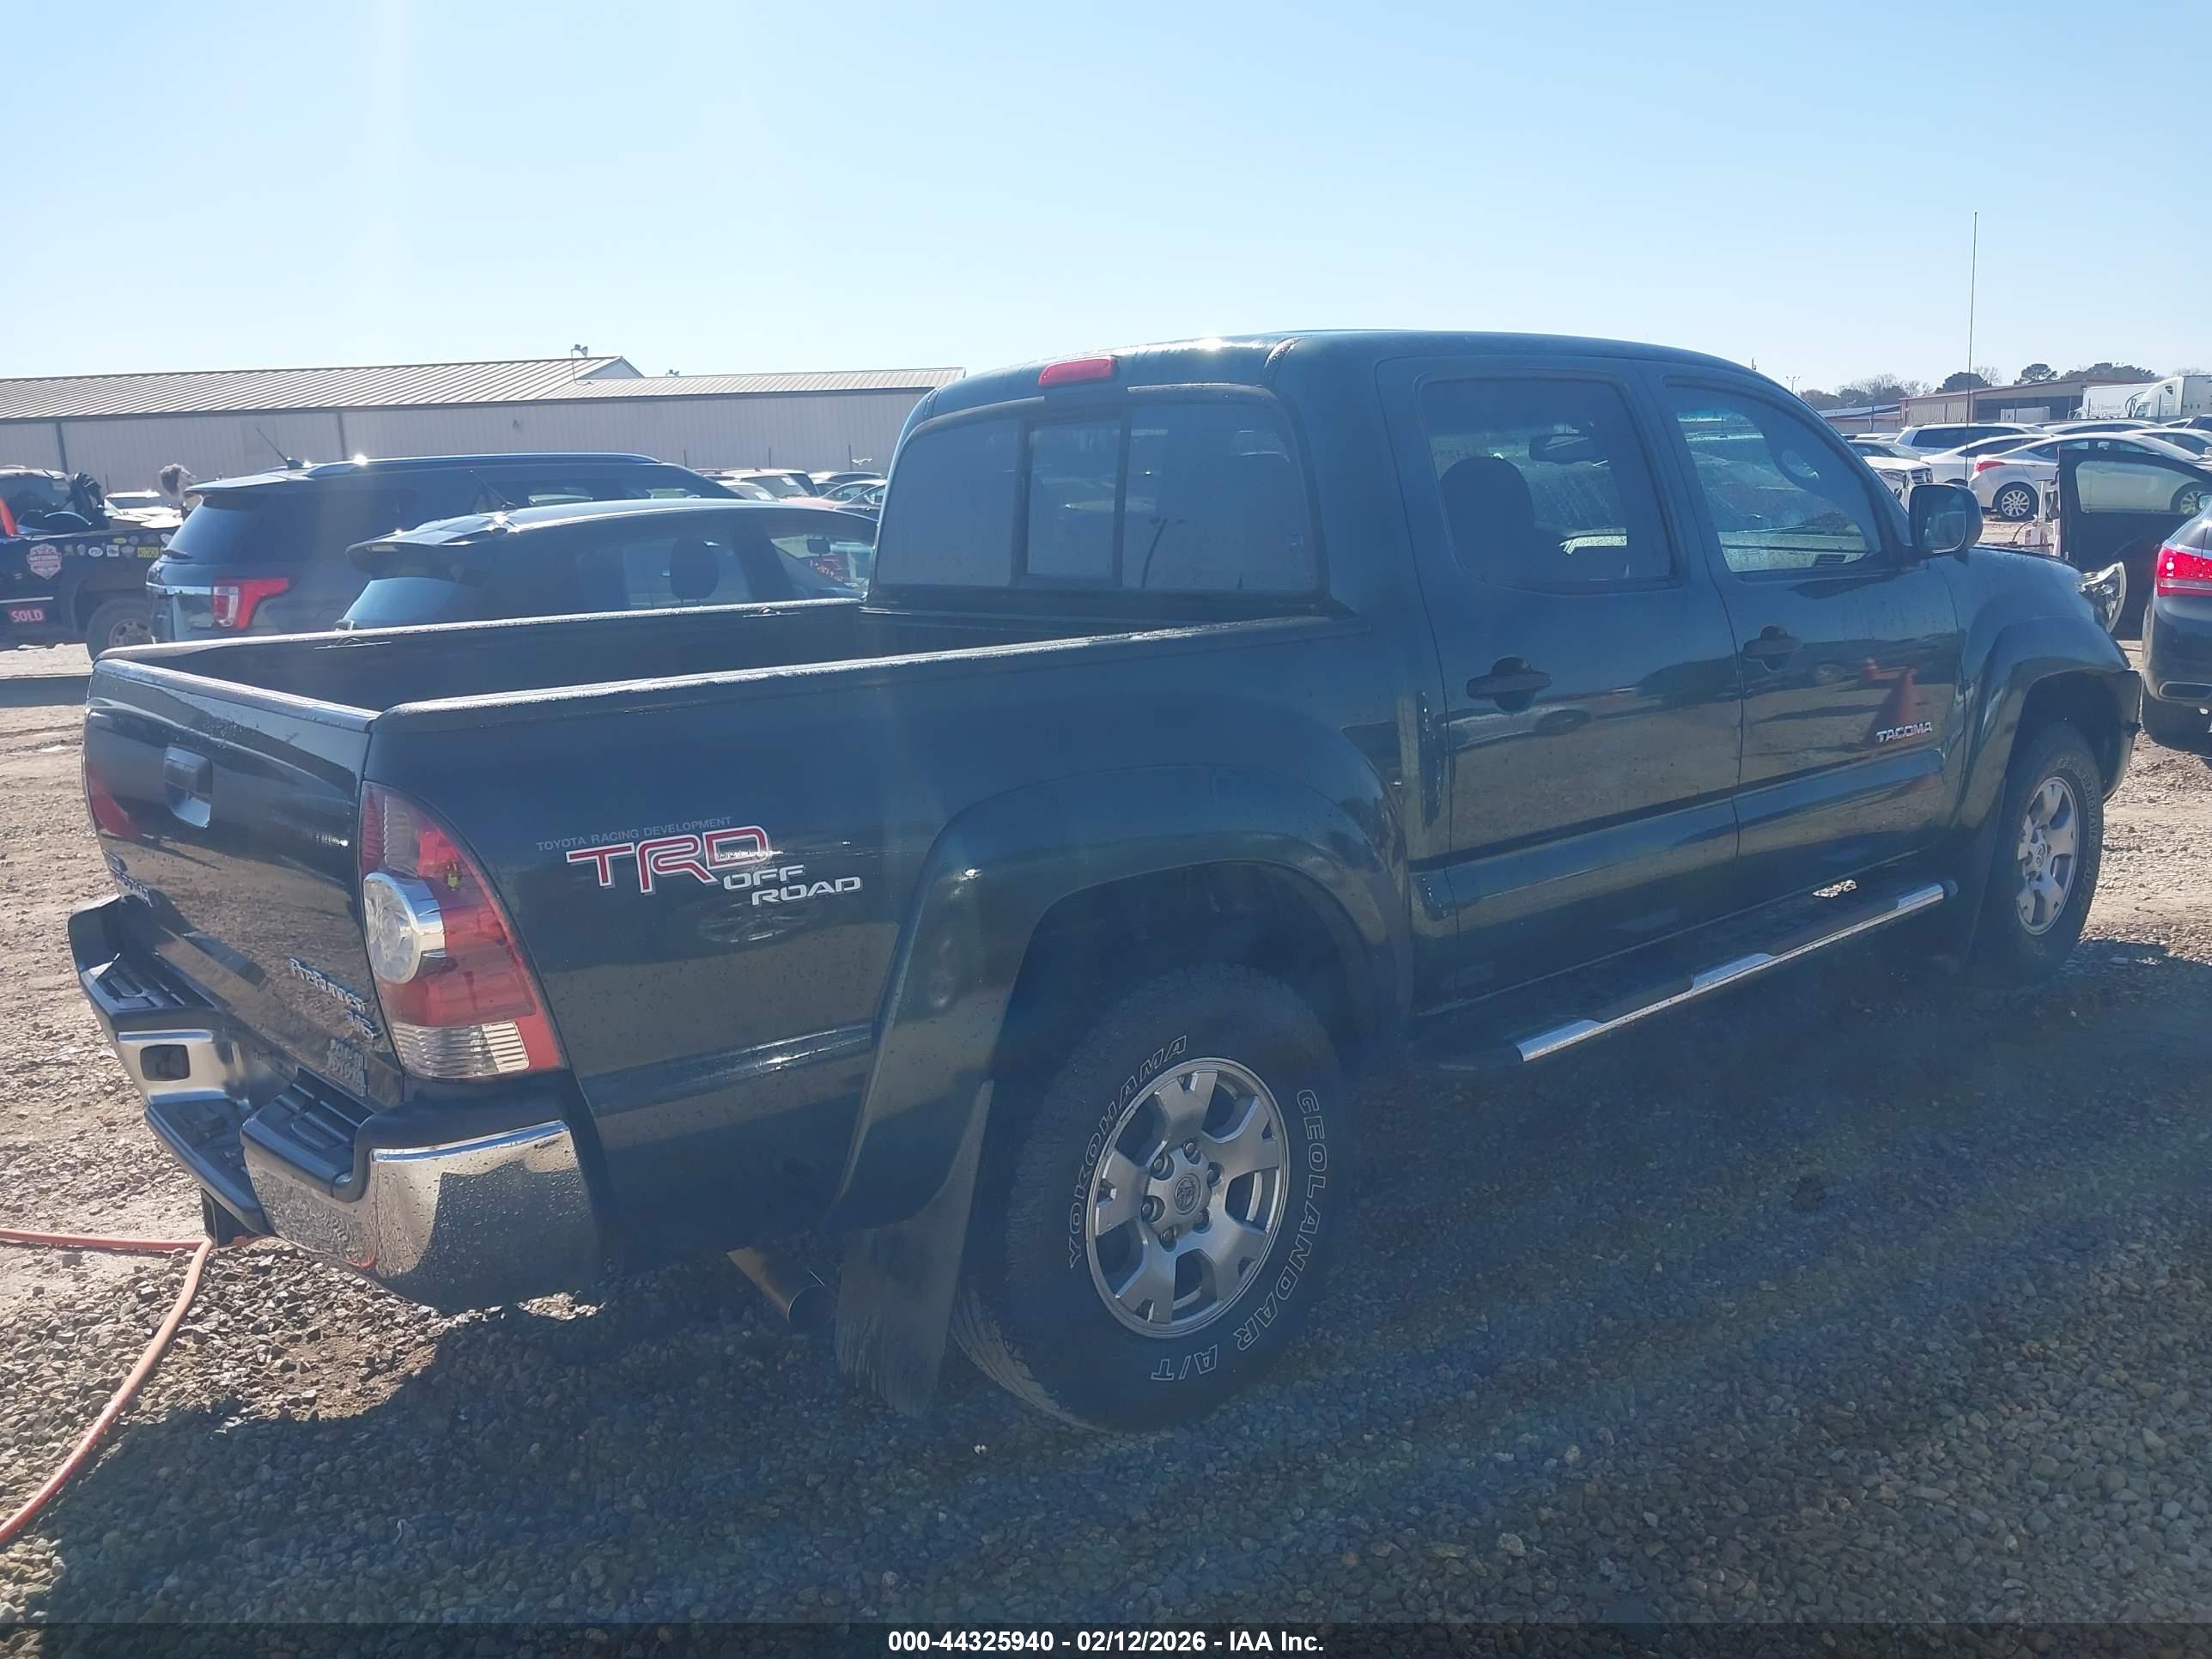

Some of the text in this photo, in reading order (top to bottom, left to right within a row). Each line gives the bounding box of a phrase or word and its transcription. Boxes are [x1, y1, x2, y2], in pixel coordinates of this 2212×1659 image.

[10, 609, 44, 623] SOLD
[1876, 721, 1933, 743] TACOMA
[536, 816, 733, 852] TOYOTA RACING DEVELOPMENT
[565, 824, 770, 894] TRD
[723, 864, 805, 891] OFF
[751, 875, 861, 906] ROAD
[1067, 1034, 1188, 1270] YOKOHAMA
[1150, 1089, 1328, 1381] GEOLANDAR A/T
